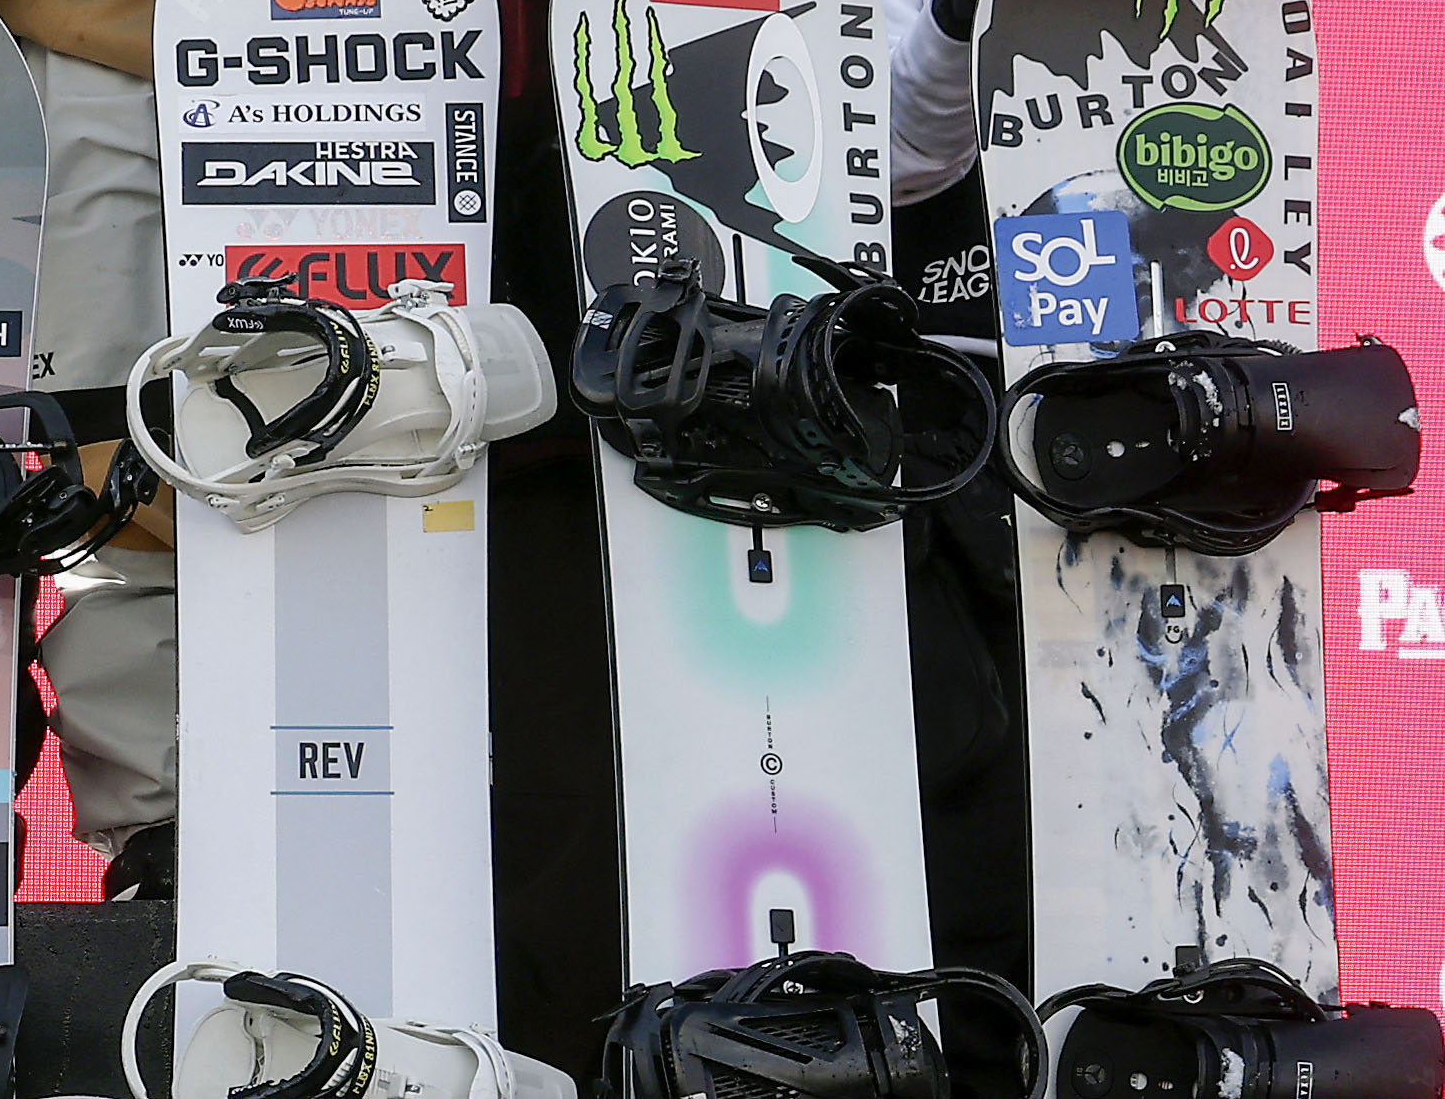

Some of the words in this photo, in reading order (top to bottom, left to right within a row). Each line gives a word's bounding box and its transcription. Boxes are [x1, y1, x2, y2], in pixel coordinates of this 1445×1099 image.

[175, 29, 486, 88] G-SHOCK
[228, 103, 264, 123] A's
[271, 103, 422, 123] HOLDINGS
[991, 51, 1243, 148] BURTON
[315, 141, 419, 160] HESTRA
[452, 109, 479, 184] STANCE
[839, 2, 888, 274] BURTON
[1135, 131, 1259, 181] bibigo
[196, 160, 422, 187] DAKINE
[1157, 169, 1210, 187] 비비고
[627, 197, 656, 287] OKIO
[662, 203, 677, 261] RAMI
[299, 252, 455, 300] FLUX
[922, 244, 991, 284] SNO
[917, 272, 990, 304] LEAG
[1031, 290, 1109, 335] Pay
[1174, 297, 1312, 326] LOTTE
[298, 741, 365, 780] REV
